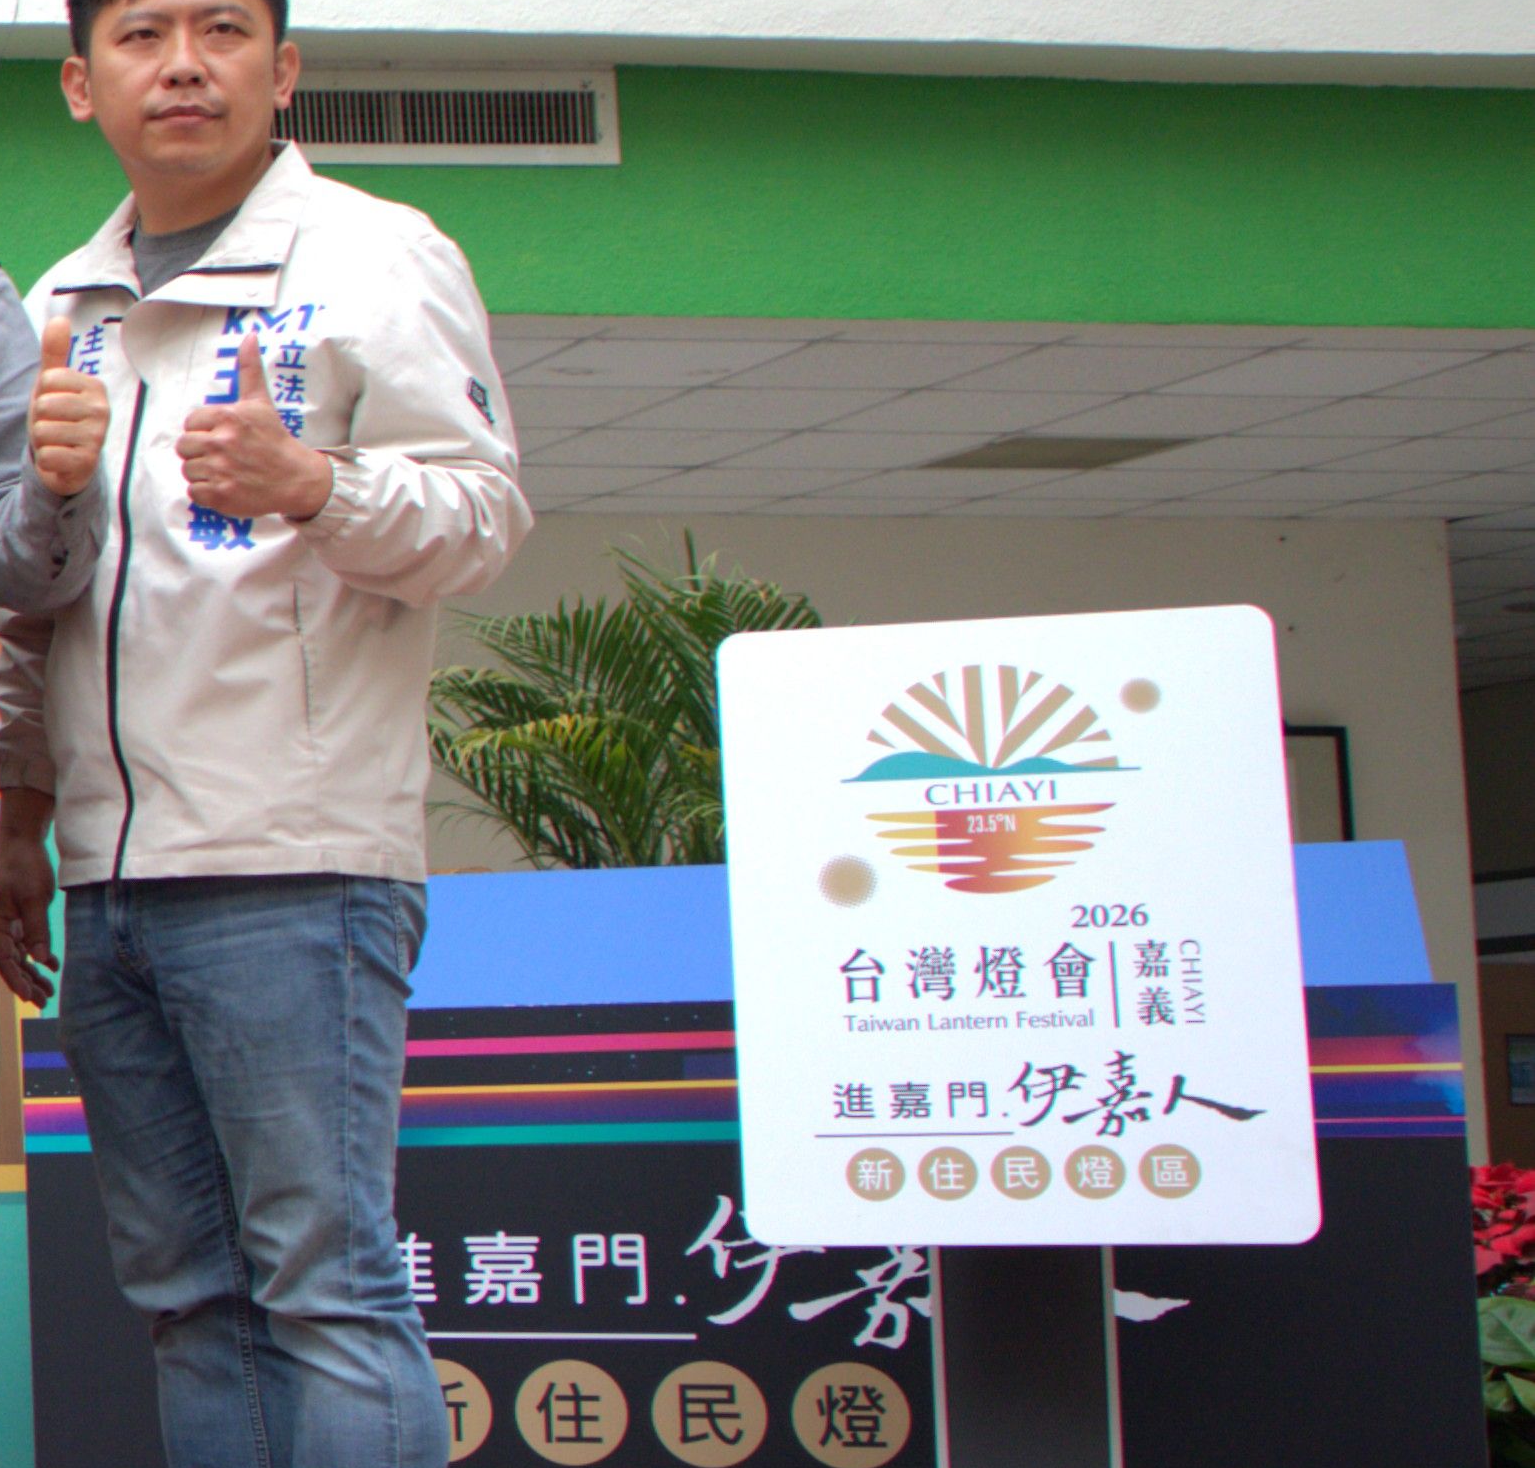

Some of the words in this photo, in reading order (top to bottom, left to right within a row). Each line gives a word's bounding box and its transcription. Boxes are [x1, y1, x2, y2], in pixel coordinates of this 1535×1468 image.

[273, 339, 307, 438] 立法委
[924, 779, 1058, 806] CHIAYI
[966, 813, 1017, 834] 23.5°N
[1070, 902, 1150, 929] 2026
[838, 940, 1097, 1005] 台灣燈會
[1134, 938, 1177, 1027] 嘉義
[1179, 938, 1207, 1025] CHIAYI
[843, 1014, 921, 1033] Taiwan
[928, 1012, 1009, 1031] Lantern
[1016, 1008, 1096, 1030] Festival
[855, 1153, 1193, 1193] 新住民燈區
